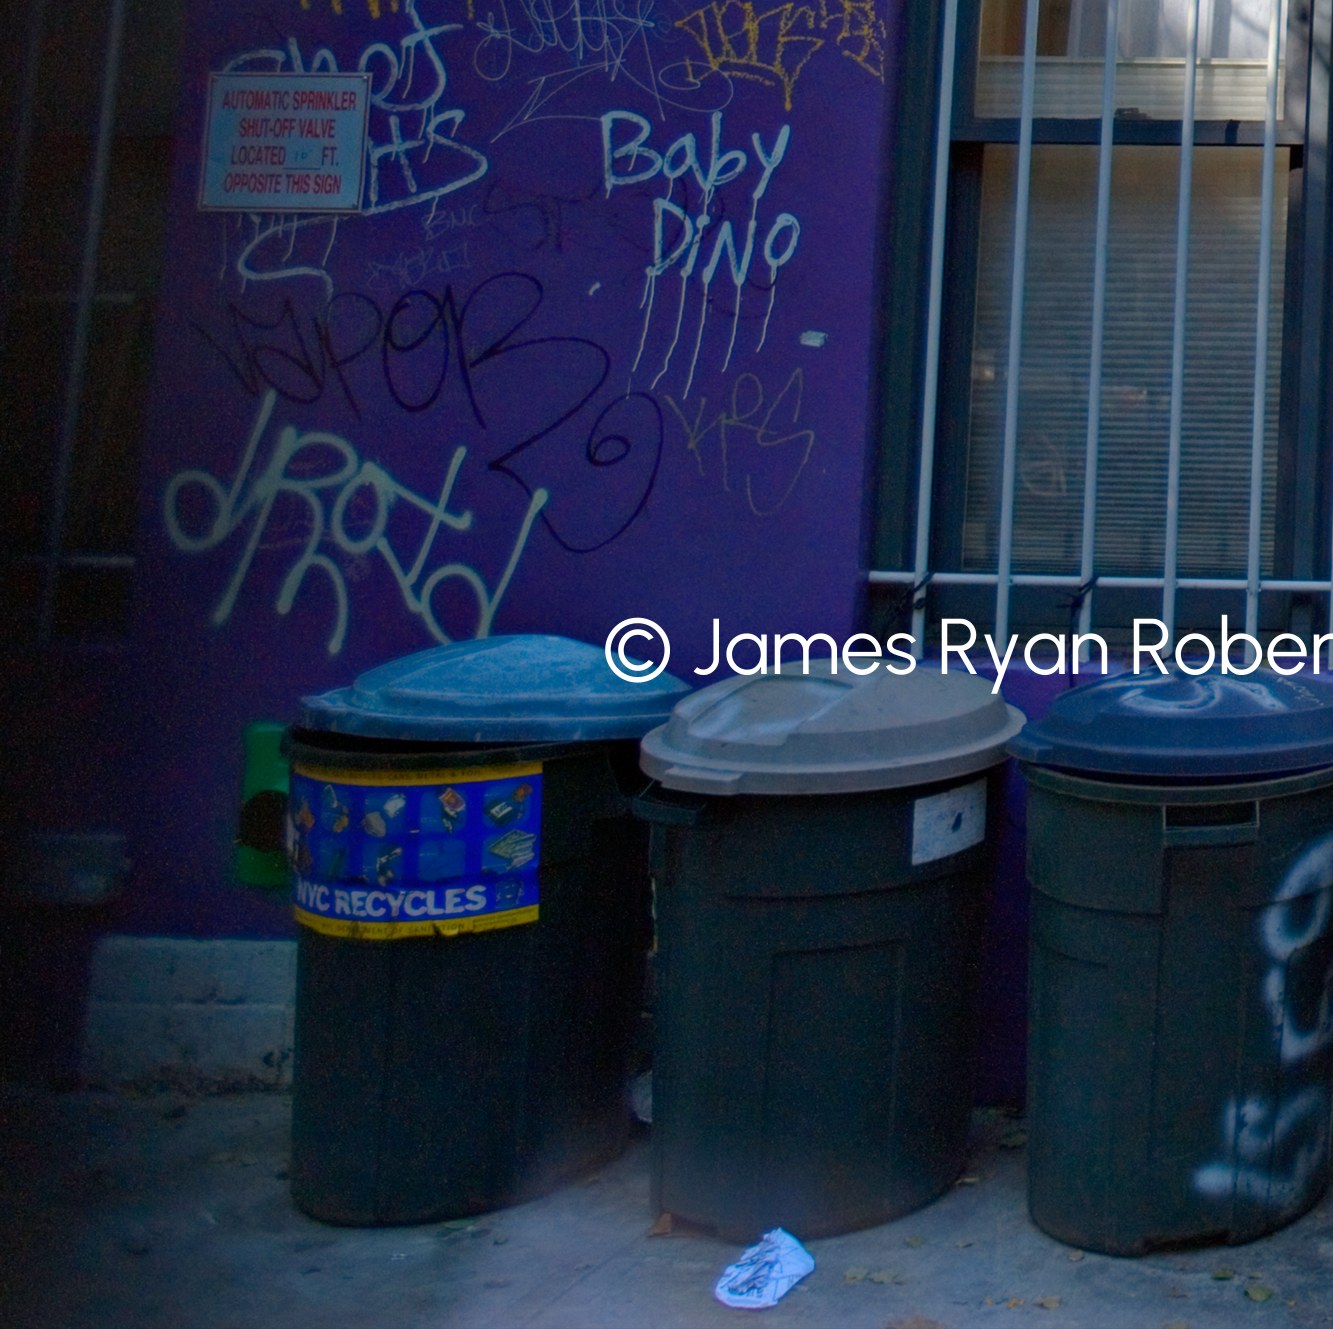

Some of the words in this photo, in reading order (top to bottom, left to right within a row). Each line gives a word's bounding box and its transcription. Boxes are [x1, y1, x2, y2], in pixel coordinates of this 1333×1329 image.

[222, 90, 290, 110] AUTOMATIC
[292, 90, 358, 111] SPRINKLER
[239, 118, 297, 139] SHUT-OFF
[299, 119, 337, 139] VALVE
[230, 146, 287, 166] LOCATED
[320, 146, 340, 167] FT.
[223, 173, 282, 193] OPPOSITE
[285, 174, 311, 194] THIS
[313, 174, 342, 194] SIGN
[297, 877, 331, 912] NYC
[334, 884, 488, 918] RECYCLES
